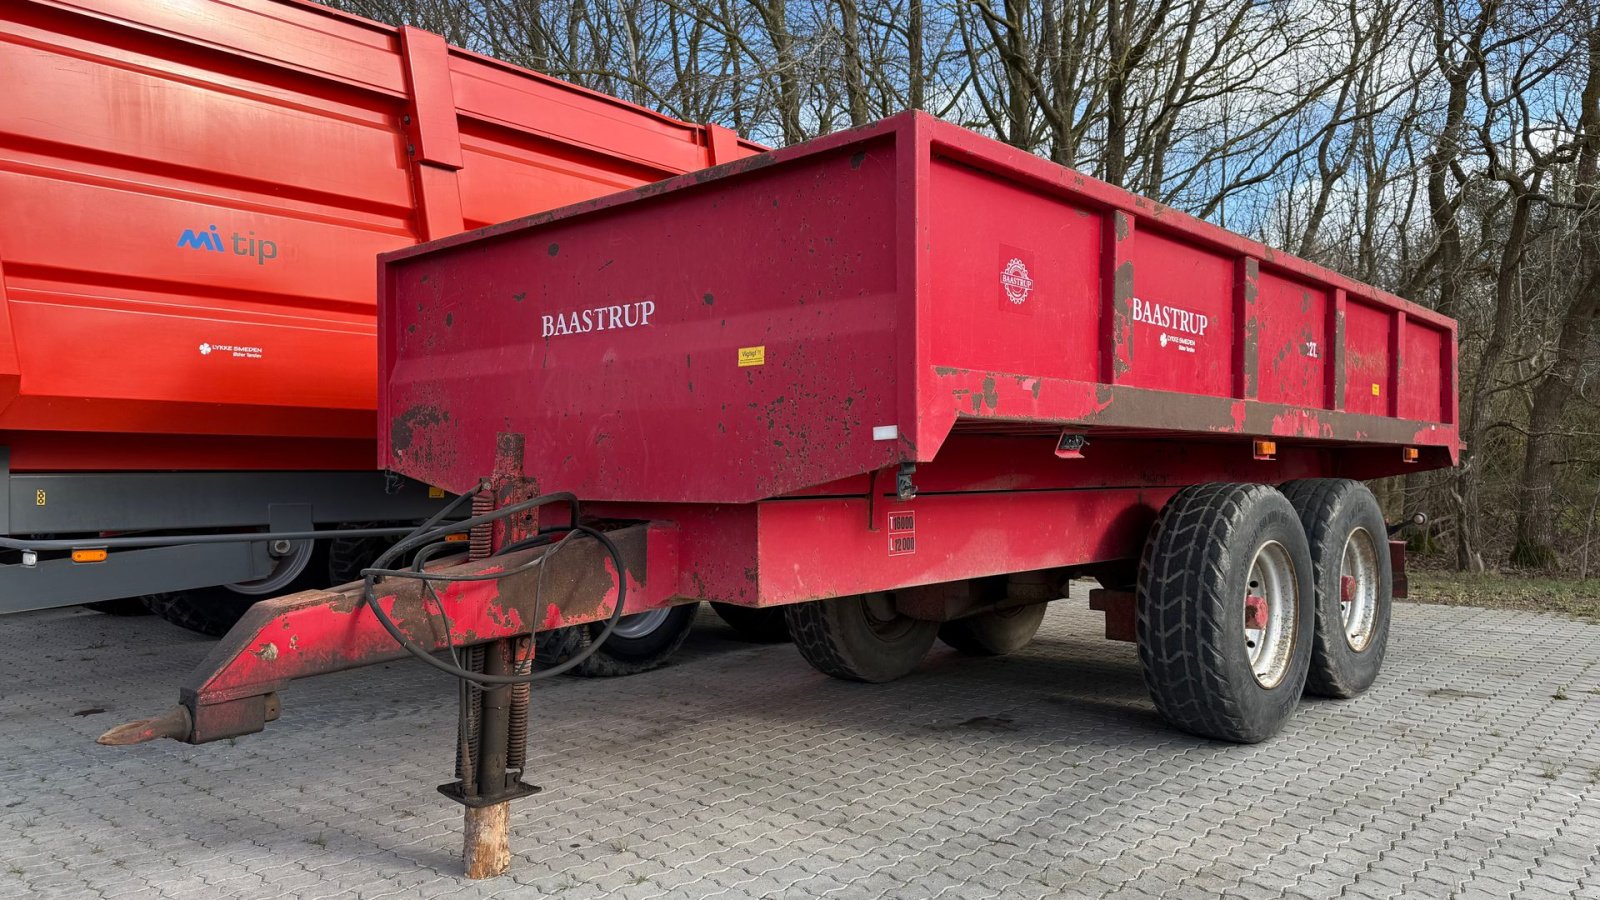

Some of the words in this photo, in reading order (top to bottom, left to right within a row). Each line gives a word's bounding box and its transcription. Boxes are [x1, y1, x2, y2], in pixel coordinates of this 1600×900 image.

[231, 231, 277, 265] tip
[541, 300, 655, 337] BAASTRUP
[1132, 297, 1208, 336] BAASTRUP
[890, 516, 894, 530] T
